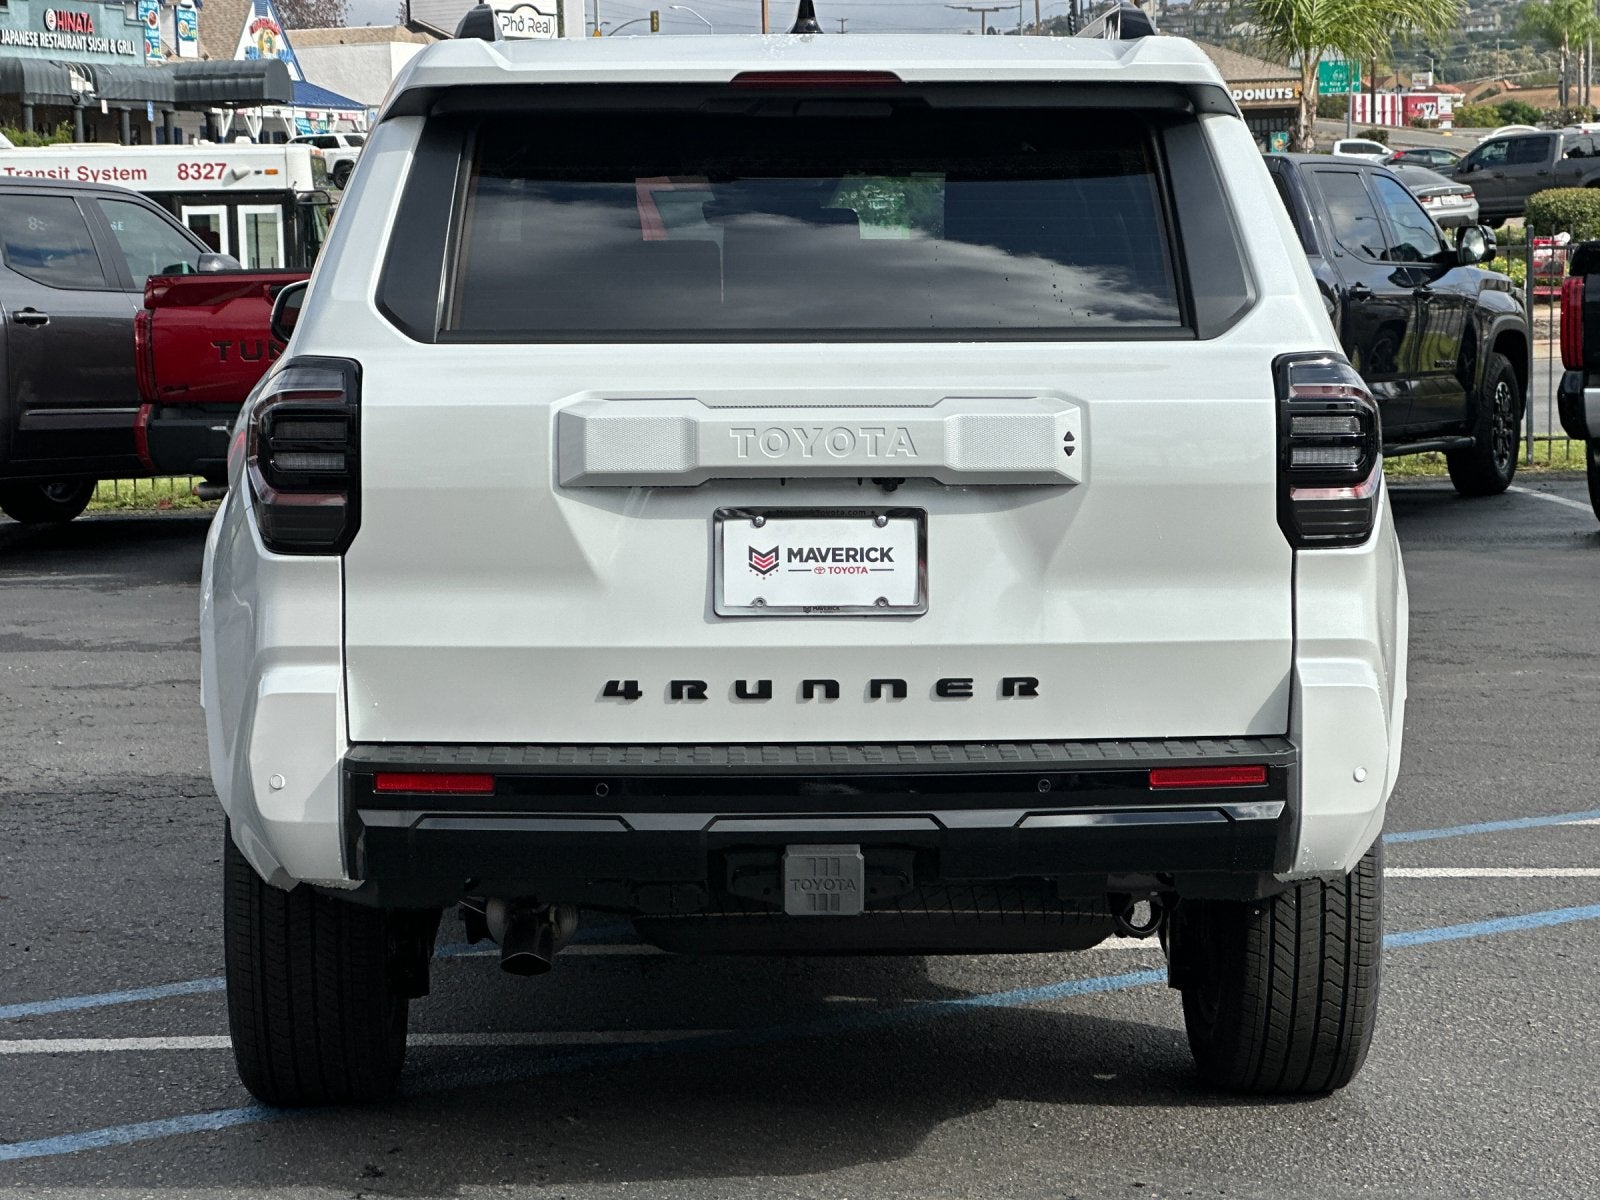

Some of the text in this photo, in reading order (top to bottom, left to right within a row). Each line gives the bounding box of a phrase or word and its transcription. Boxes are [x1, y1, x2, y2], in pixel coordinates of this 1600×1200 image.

[56, 10, 94, 33] HINATA
[528, 17, 551, 34] Real
[1, 29, 39, 47] JAPANESE
[40, 32, 87, 51] RESTAURANT
[88, 36, 109, 53] SUSHI
[110, 39, 116, 53] &
[117, 39, 136, 55] GRILL
[1232, 87, 1294, 101] DONUTS
[4, 163, 227, 183] Transit System 8327
[729, 426, 919, 459] TOYOTA
[787, 547, 895, 563] MAVERICK
[827, 566, 869, 575] TOYOTA
[602, 677, 1040, 702] 4RUNNER
[790, 879, 857, 892] TOYOTA
